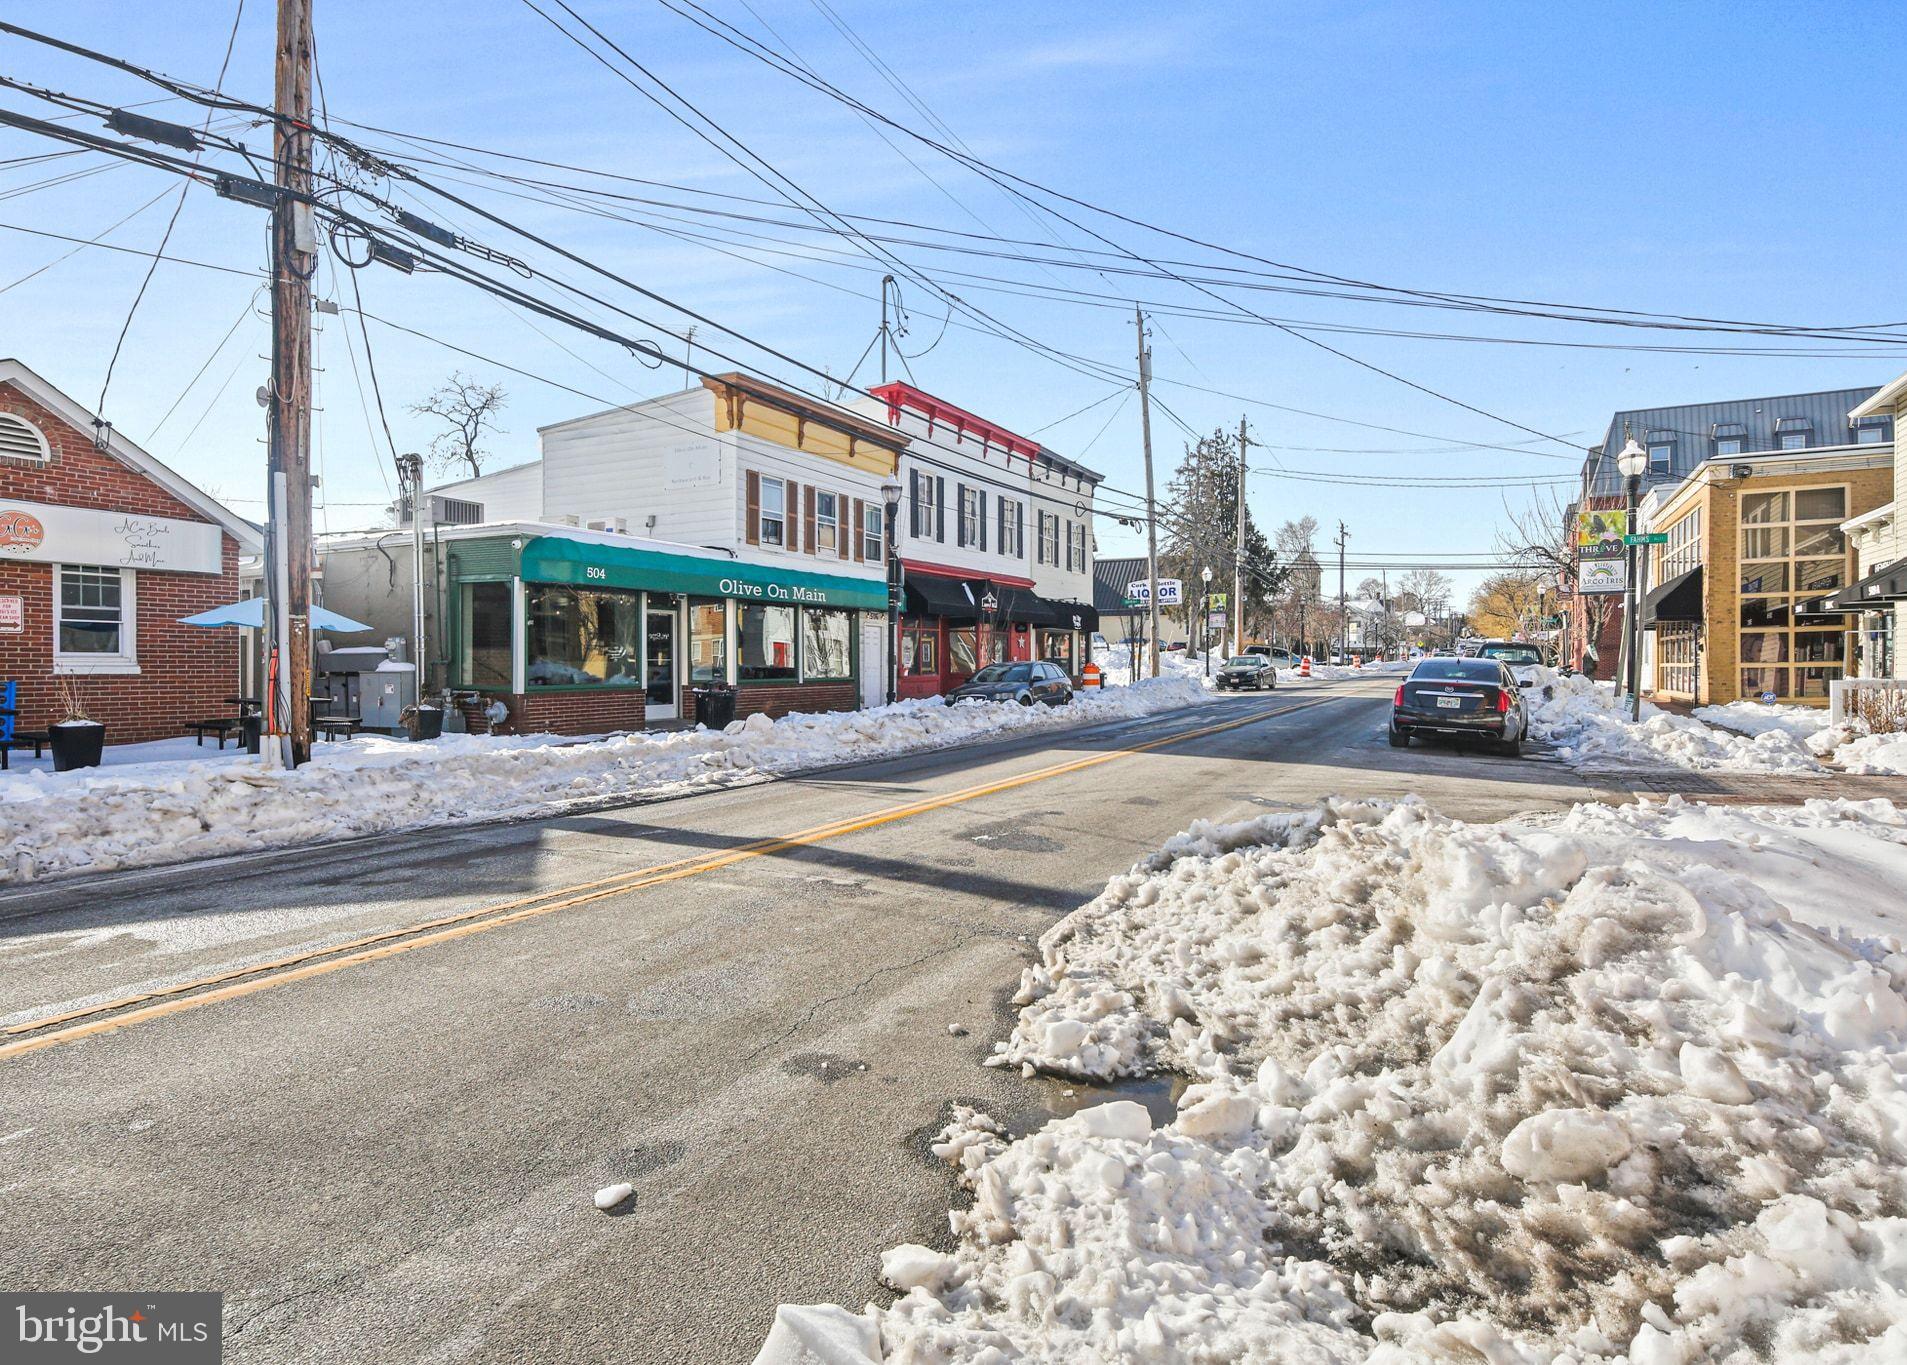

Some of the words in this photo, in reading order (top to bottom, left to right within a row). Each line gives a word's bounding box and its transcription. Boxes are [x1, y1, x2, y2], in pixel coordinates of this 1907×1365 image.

[587, 567, 605, 579] 504
[719, 579, 762, 597] Olive
[767, 584, 788, 599] On
[793, 586, 827, 602] Main
[1129, 587, 1177, 599] LIQOR
